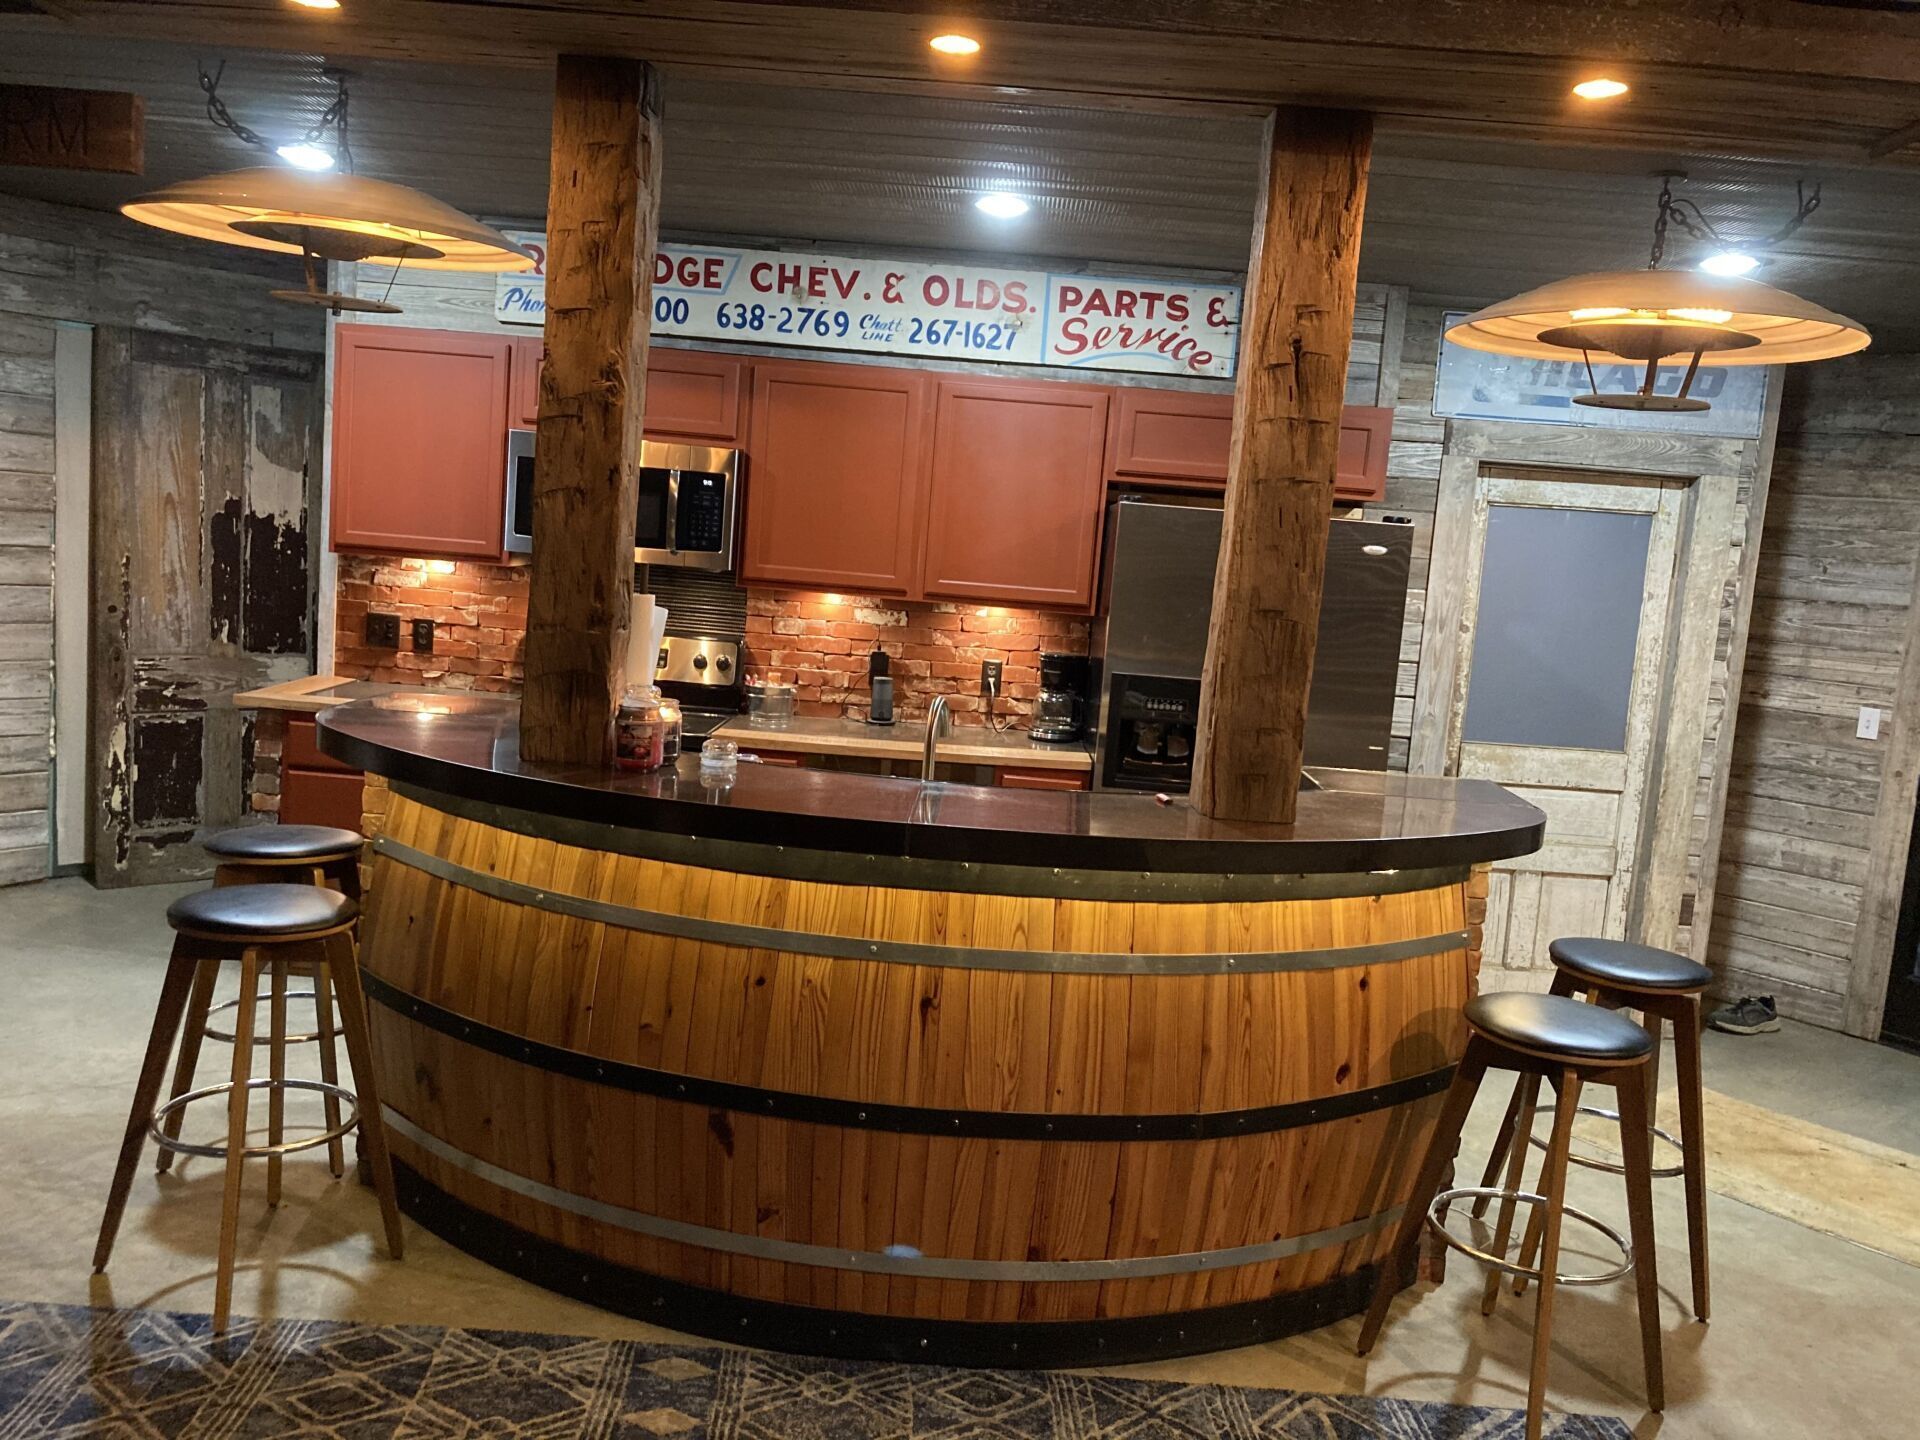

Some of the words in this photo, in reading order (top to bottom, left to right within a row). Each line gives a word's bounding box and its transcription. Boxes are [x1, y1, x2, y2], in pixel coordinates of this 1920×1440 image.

[750, 262, 871, 301] CHEV.
[882, 272, 905, 304] &
[923, 275, 1036, 314] OLDS.
[1058, 286, 1190, 322] PARTS
[1206, 296, 1229, 328] &
[717, 302, 850, 338] 638-2769
[861, 331, 895, 343] LINE
[908, 317, 1020, 351] 267-1627
[1054, 317, 1213, 372] Service
